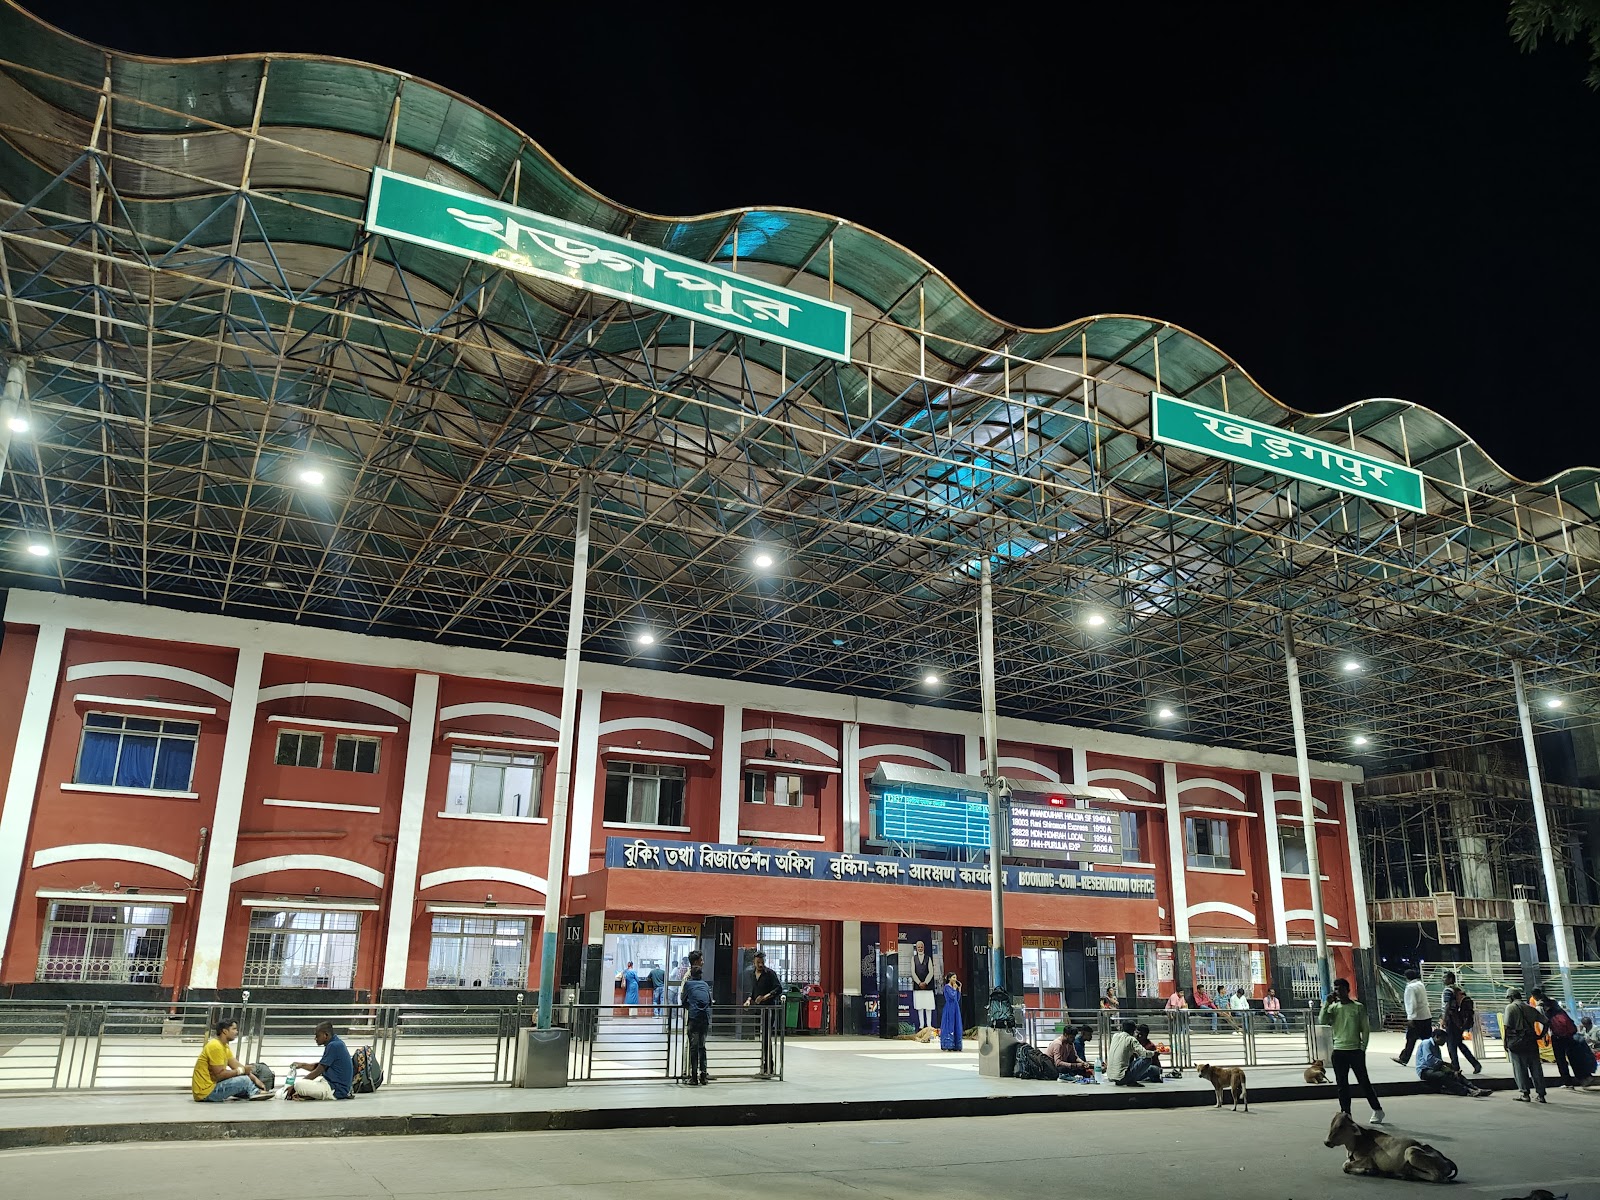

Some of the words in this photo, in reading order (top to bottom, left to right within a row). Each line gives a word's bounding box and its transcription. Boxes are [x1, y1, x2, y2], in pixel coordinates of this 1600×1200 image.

[1194, 411, 1395, 487] खड़गपुर
[1011, 808, 1028, 816] 12444
[1065, 812, 1083, 822] HALDIA
[1067, 832, 1086, 842] LOCAL
[1068, 843, 1081, 851] EXP
[624, 840, 660, 868] বুকিং
[664, 846, 695, 868] তথা
[700, 844, 771, 872] রিজার্ভেশন
[775, 850, 815, 875] অফিস
[909, 863, 956, 883] आरक्षण
[1131, 878, 1155, 894] OFFICE
[567, 926, 581, 940] IN
[604, 924, 630, 932] ENTRY
[672, 925, 697, 933] ENTRY
[719, 932, 732, 946] IN
[1042, 939, 1060, 947] EXIT
[974, 945, 988, 955] OUT
[1085, 947, 1098, 956] OUT
